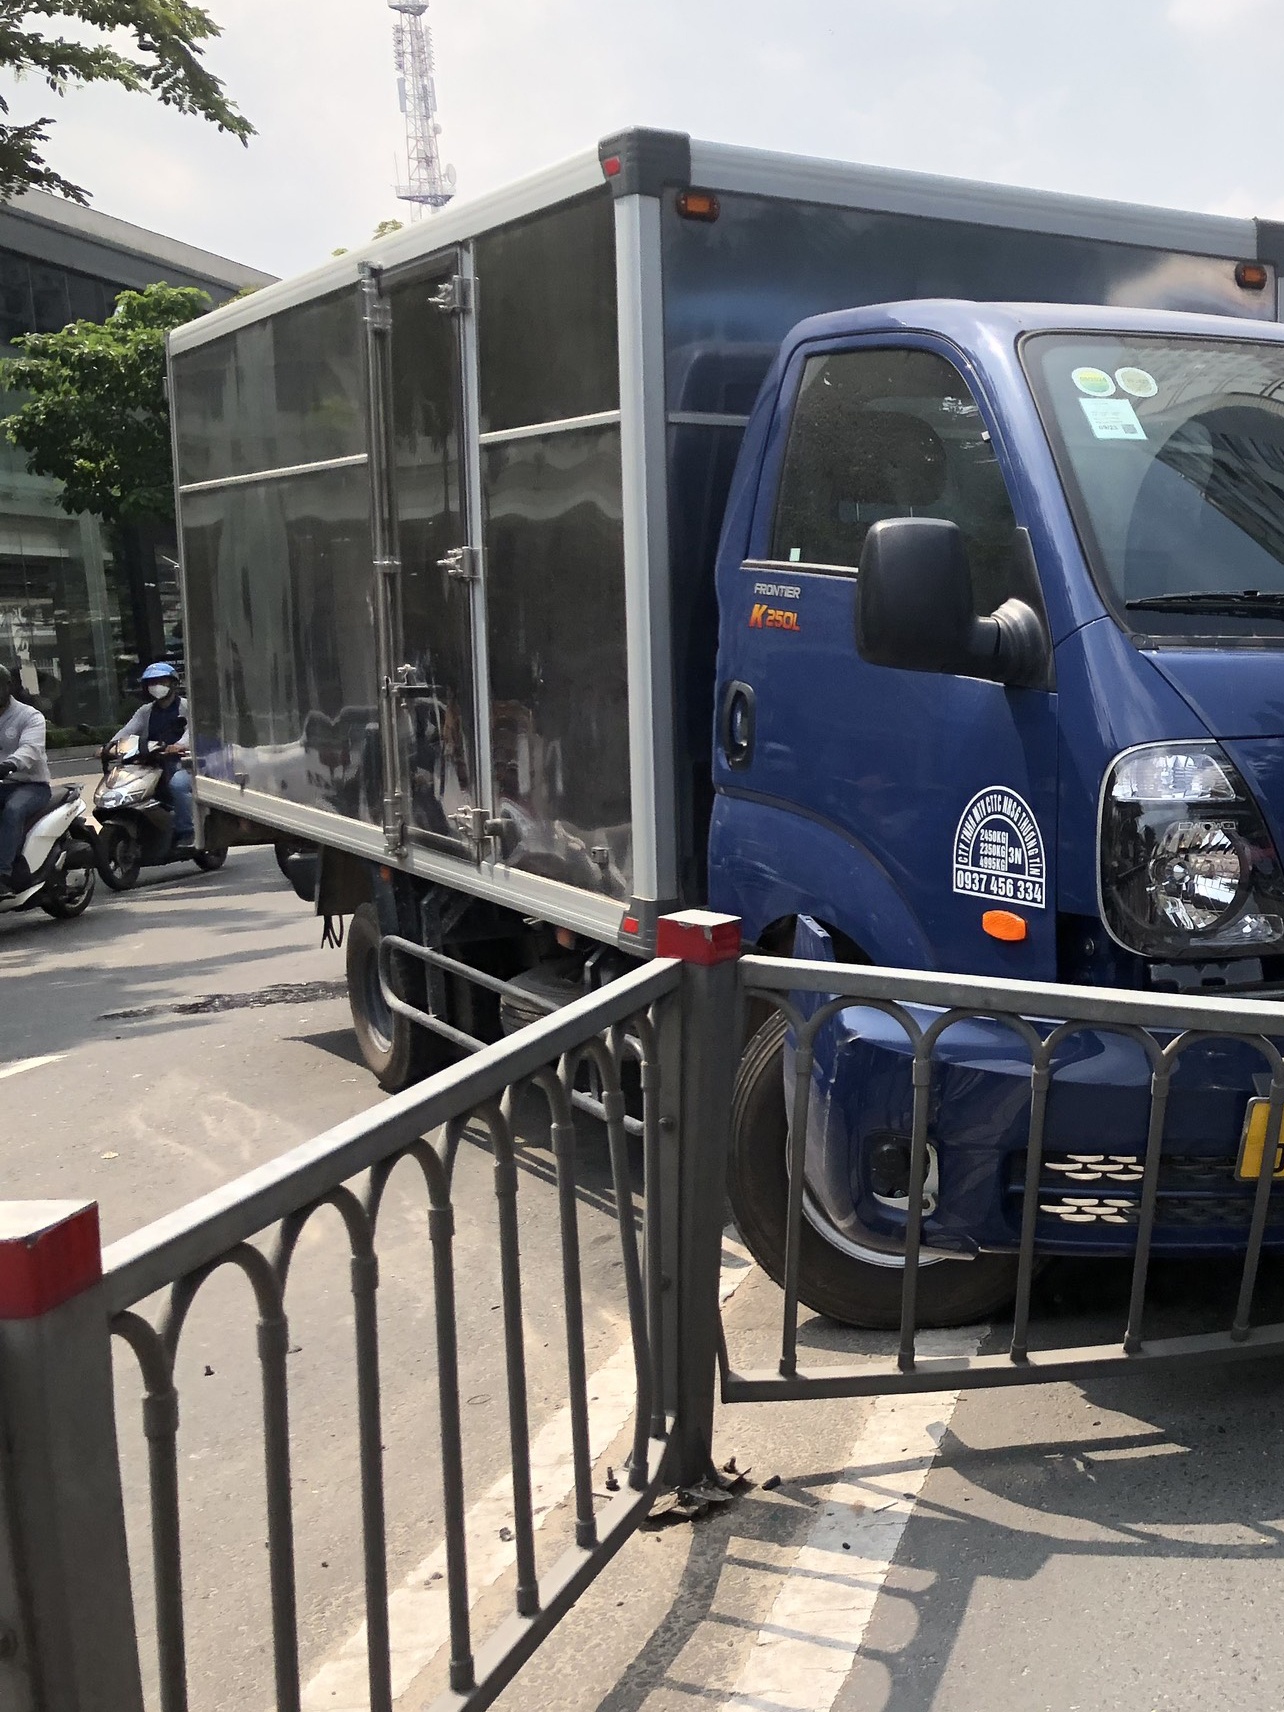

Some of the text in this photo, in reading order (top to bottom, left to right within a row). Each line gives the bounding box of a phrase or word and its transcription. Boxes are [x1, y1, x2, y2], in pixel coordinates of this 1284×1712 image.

[754, 582, 801, 599] FRONTIER
[972, 799, 987, 824] MTV
[985, 794, 1002, 813] CTTC
[960, 814, 977, 844] TNHH
[980, 828, 1007, 843] 2450KG
[957, 843, 970, 863] CTY
[979, 842, 1006, 858] 2350KG
[1008, 846, 1023, 865] 3N
[956, 870, 1042, 902] 0937 456 334
